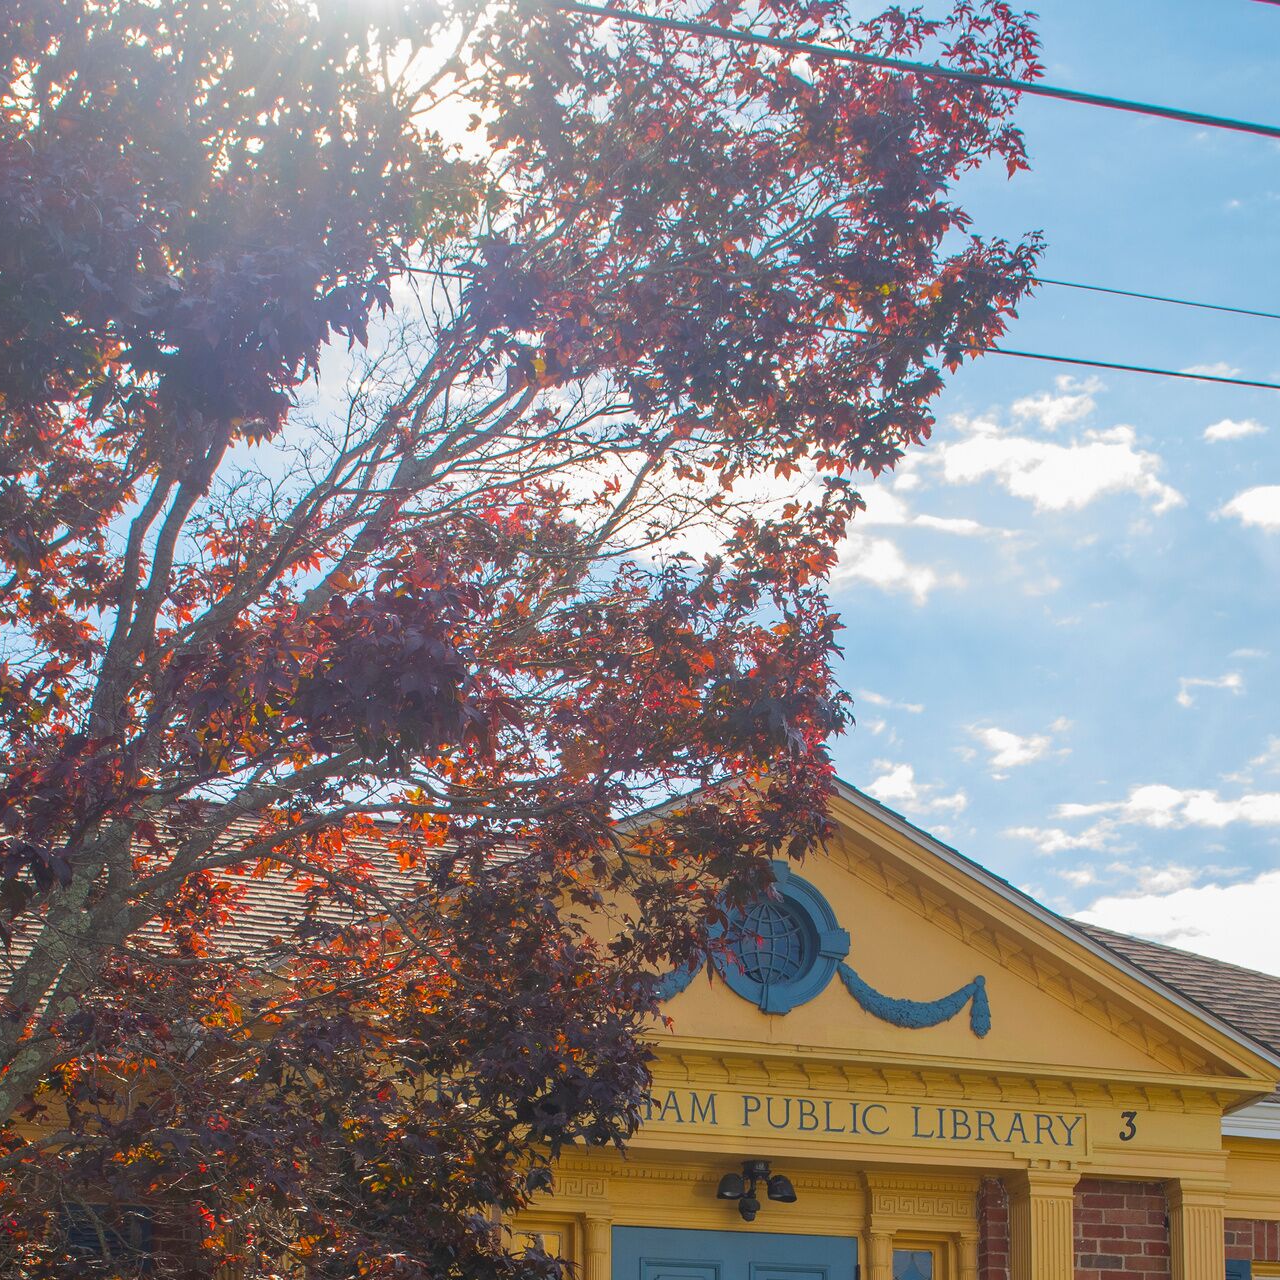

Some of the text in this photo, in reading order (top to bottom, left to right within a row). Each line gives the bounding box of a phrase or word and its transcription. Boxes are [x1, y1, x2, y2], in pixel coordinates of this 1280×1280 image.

[741, 1095, 890, 1135] PUBLIC
[911, 1106, 1082, 1146] LIBRARY
[1119, 1111, 1137, 1141] 3
